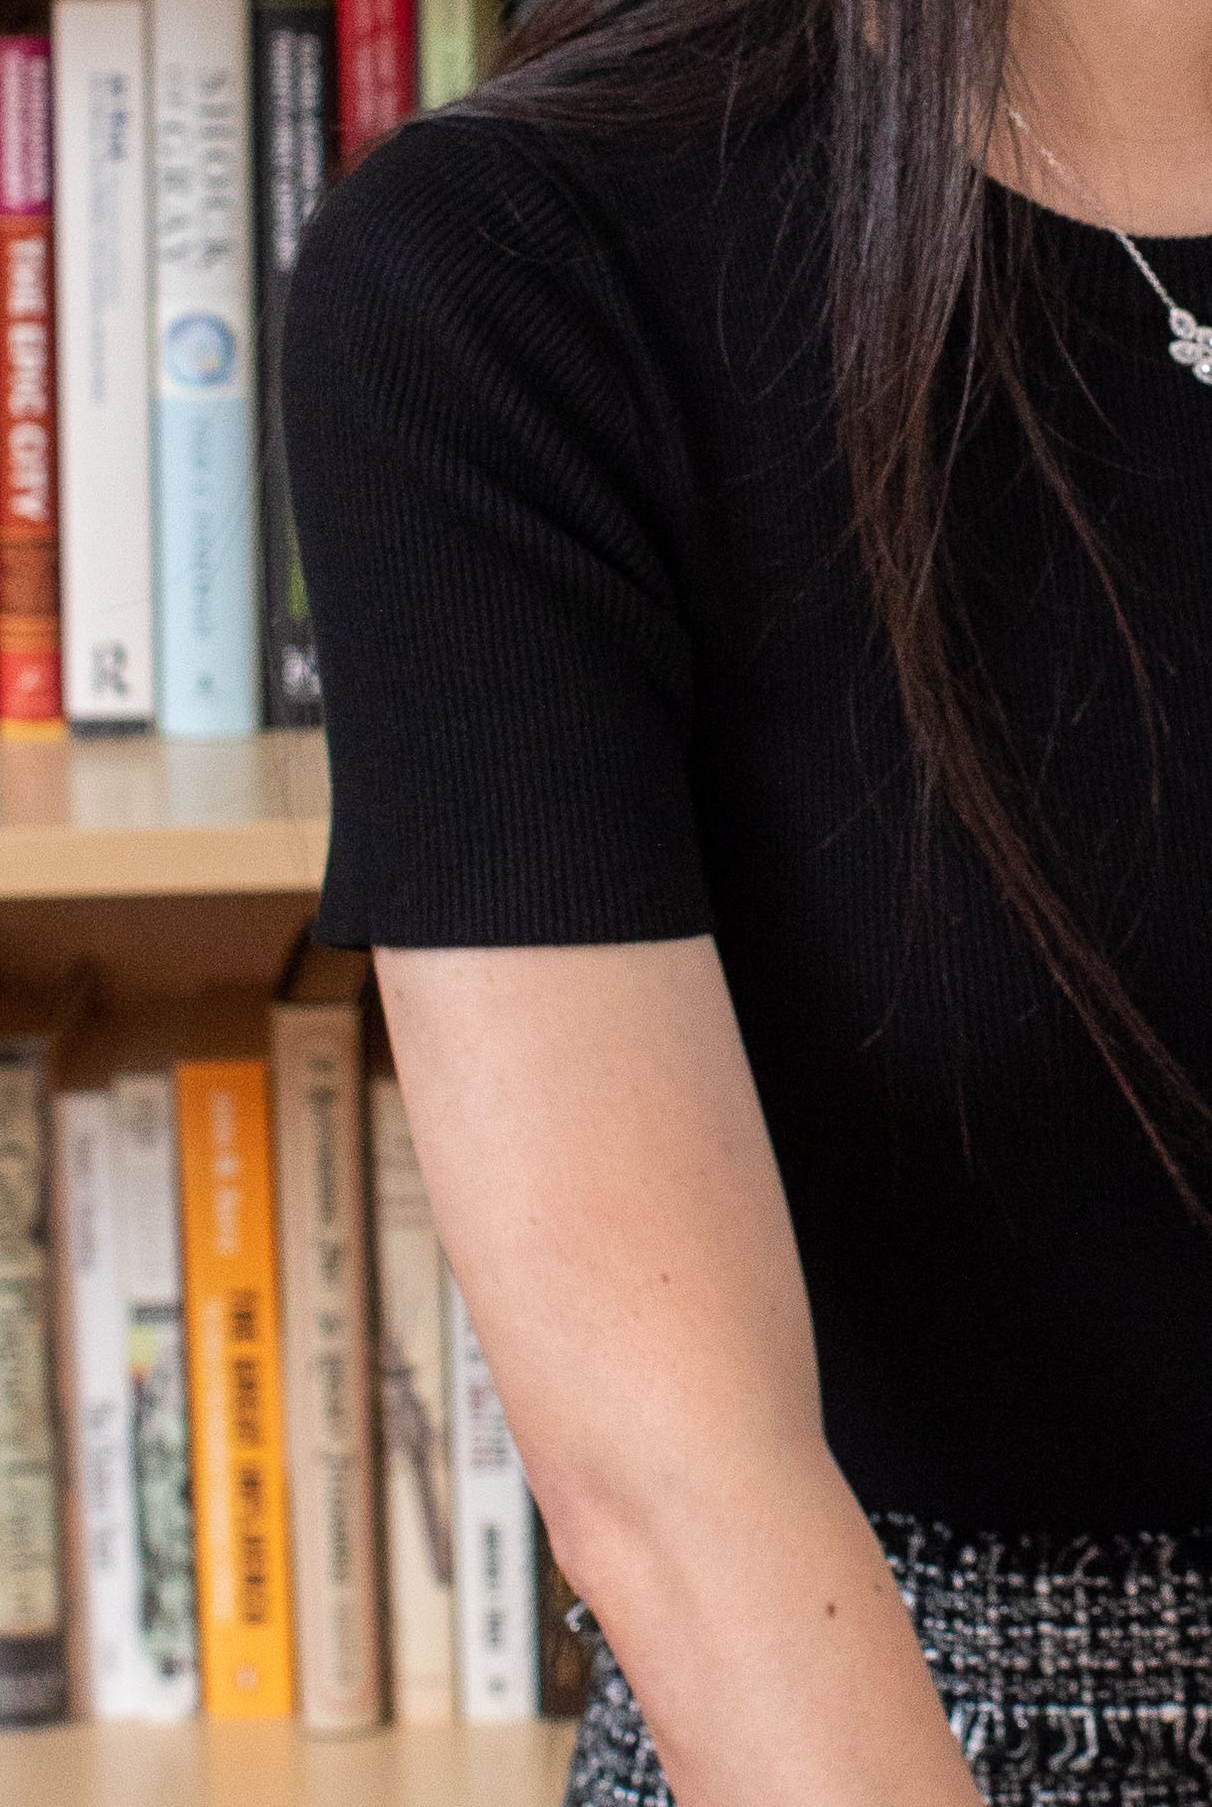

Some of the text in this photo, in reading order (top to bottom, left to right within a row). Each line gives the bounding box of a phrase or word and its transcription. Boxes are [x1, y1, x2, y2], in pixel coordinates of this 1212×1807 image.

[195, 69, 238, 266] SHOCK
[6, 236, 44, 317] THE
[6, 322, 46, 416] EPIC
[7, 422, 48, 523] CITY
